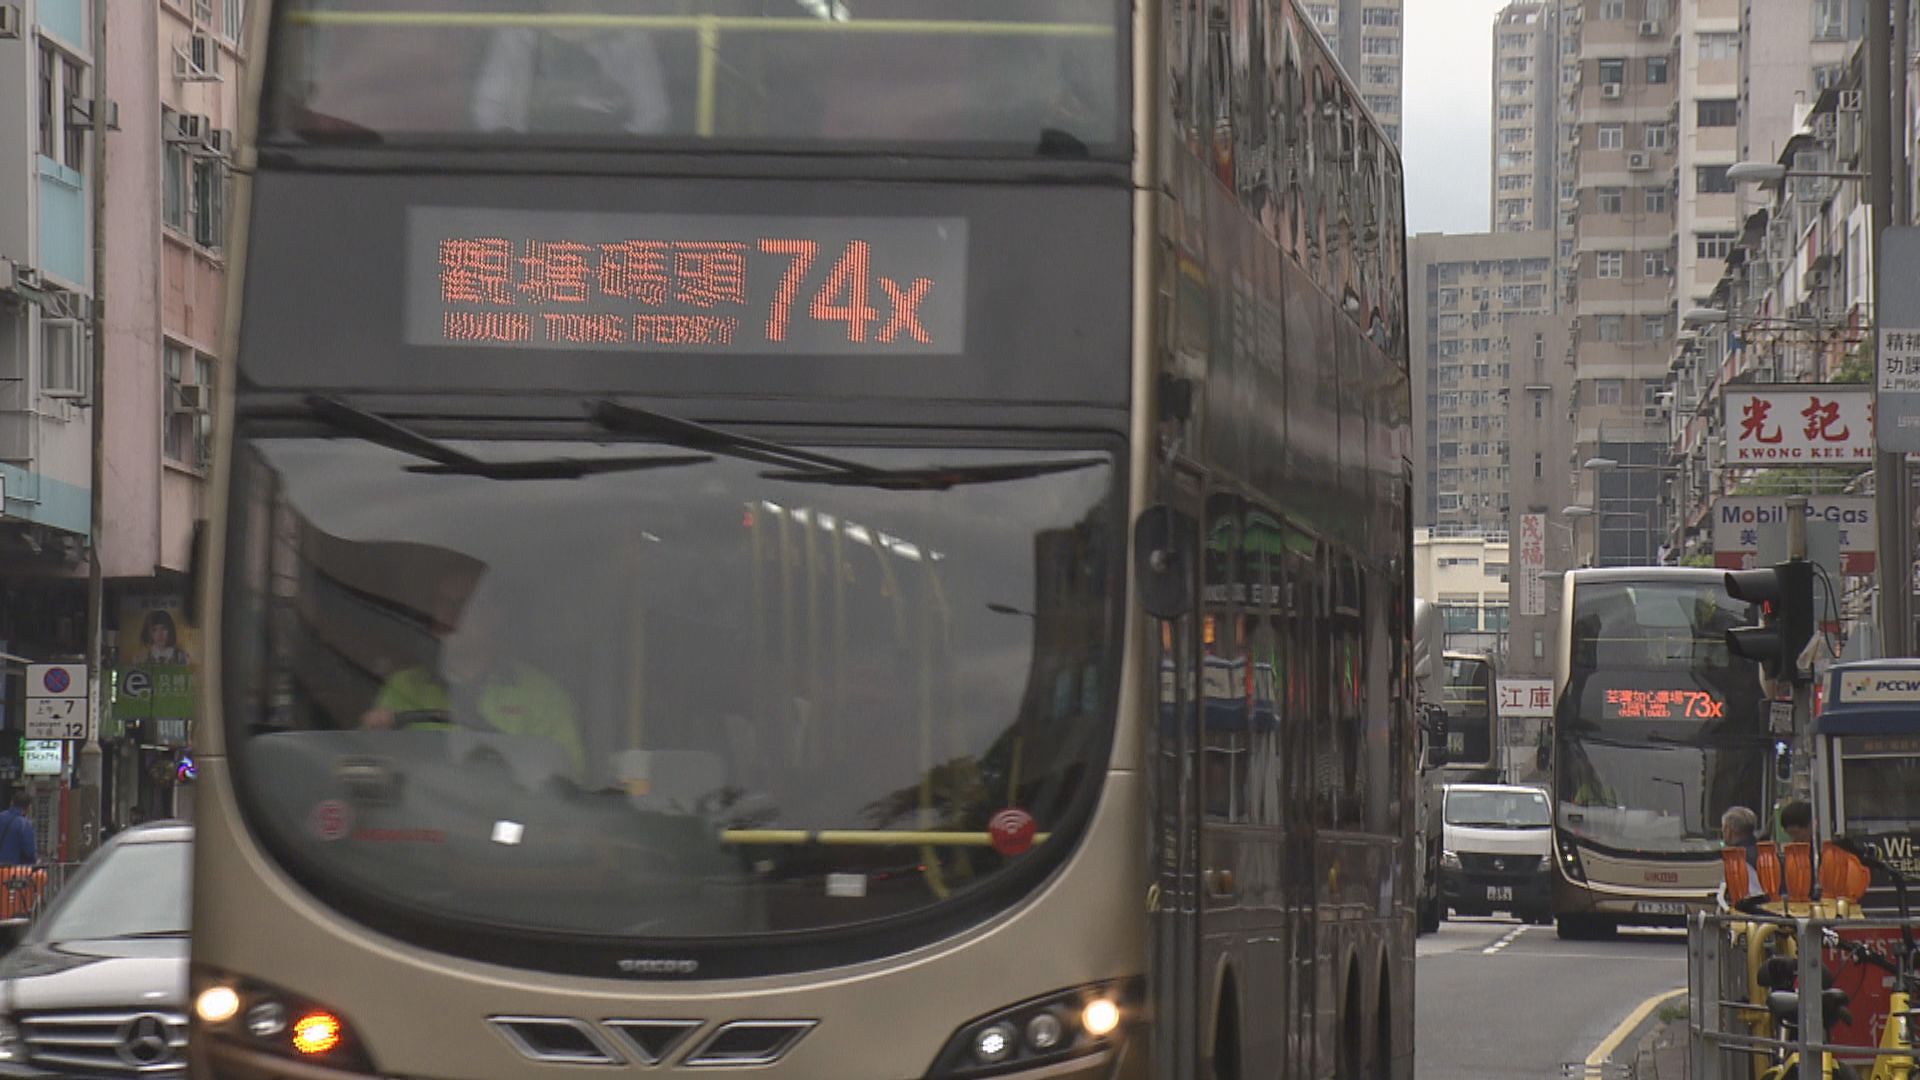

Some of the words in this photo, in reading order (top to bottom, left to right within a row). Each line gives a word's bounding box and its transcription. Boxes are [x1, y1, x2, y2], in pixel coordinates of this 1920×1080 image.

[438, 238, 748, 307] 觀塘碼頭
[756, 237, 935, 343] 74x
[1739, 396, 1873, 443] 光記
[1739, 447, 1802, 459] KWONG
[1811, 447, 1844, 458] KEE
[1853, 447, 1872, 458] MI
[1722, 506, 1783, 523] Mobil
[1803, 506, 1868, 523] P-Gas
[1876, 680, 1920, 691] PCCW
[65, 700, 75, 714] 7
[1683, 691, 1723, 717] 73x
[65, 722, 83, 737] 12
